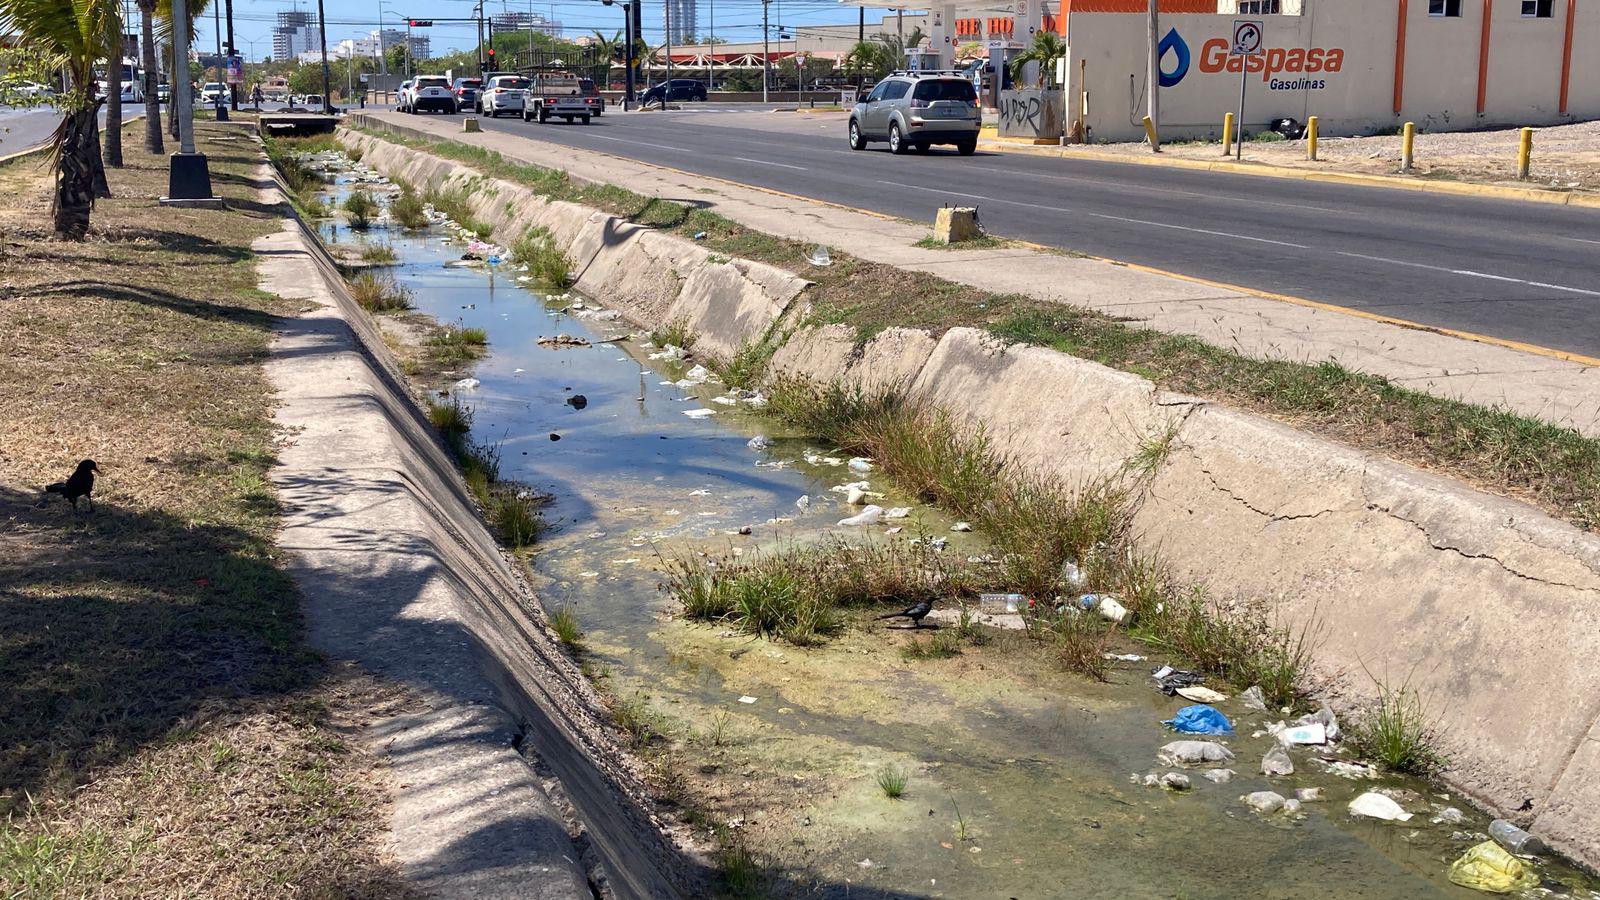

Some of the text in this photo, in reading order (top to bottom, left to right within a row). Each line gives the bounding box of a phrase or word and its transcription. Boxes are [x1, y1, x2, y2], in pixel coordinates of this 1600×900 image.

[955, 17, 1014, 35] HE HO
[1199, 38, 1345, 82] Gaspasa
[1270, 78, 1325, 91] Gasolinas
